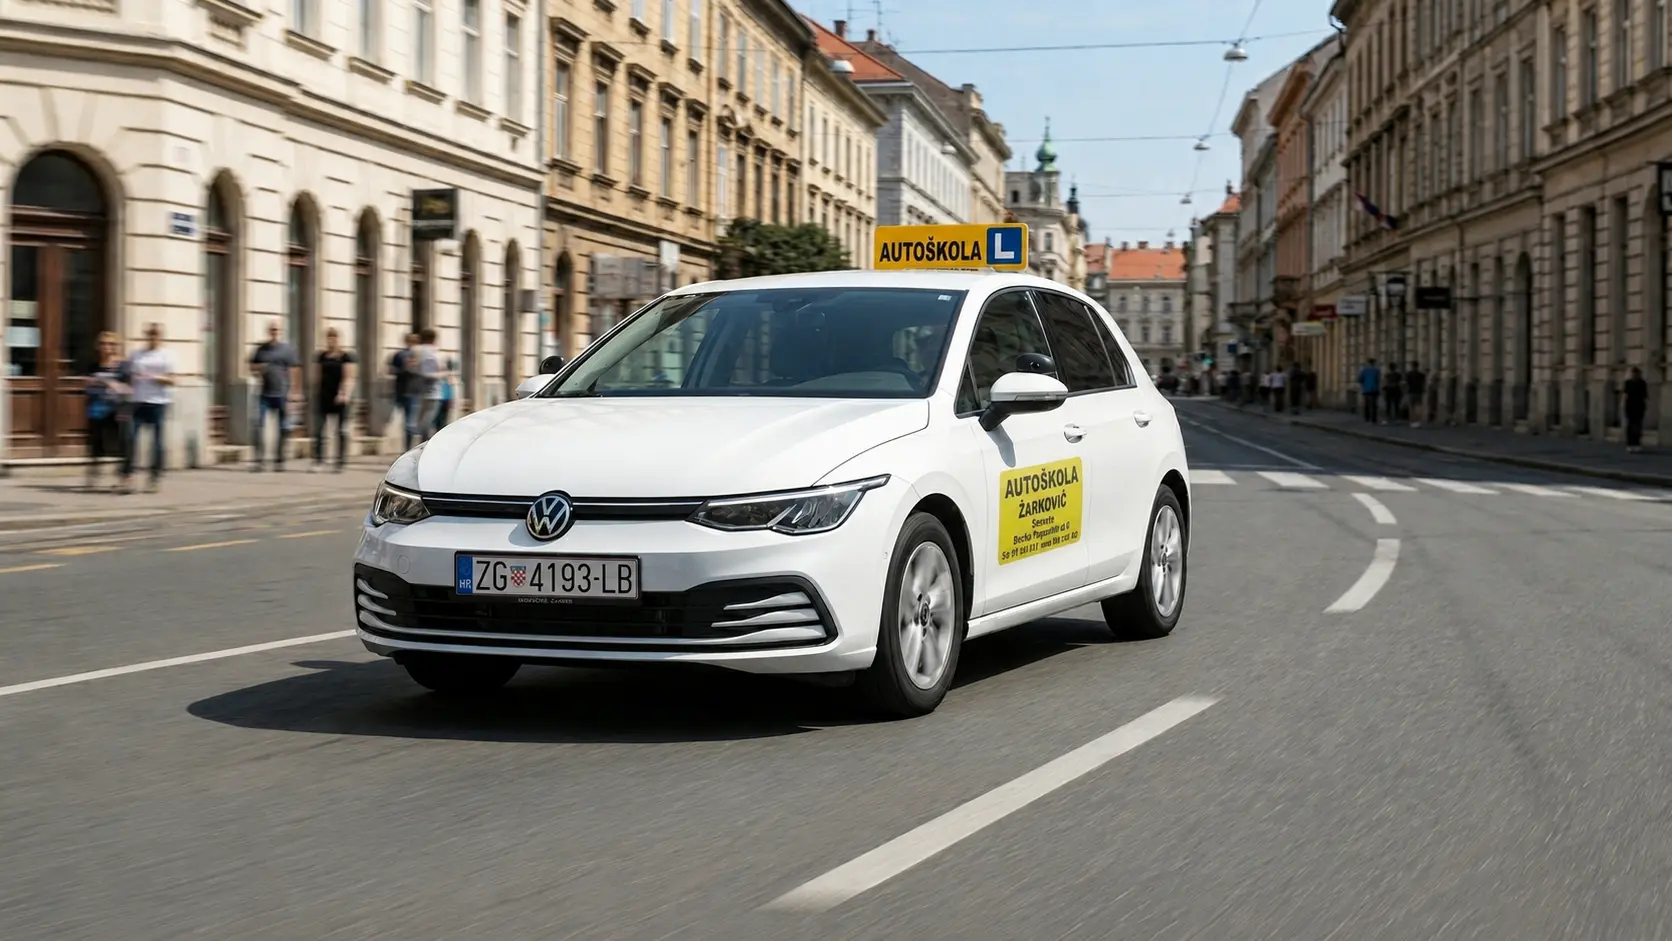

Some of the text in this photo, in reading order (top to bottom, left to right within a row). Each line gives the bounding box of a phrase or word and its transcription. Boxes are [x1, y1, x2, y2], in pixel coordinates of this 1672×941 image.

[879, 232, 1014, 262] AUTOŠKOLA L
[1005, 465, 1079, 499] AUTOŠKOLA
[459, 560, 632, 594] HR ZG 4193-LB
